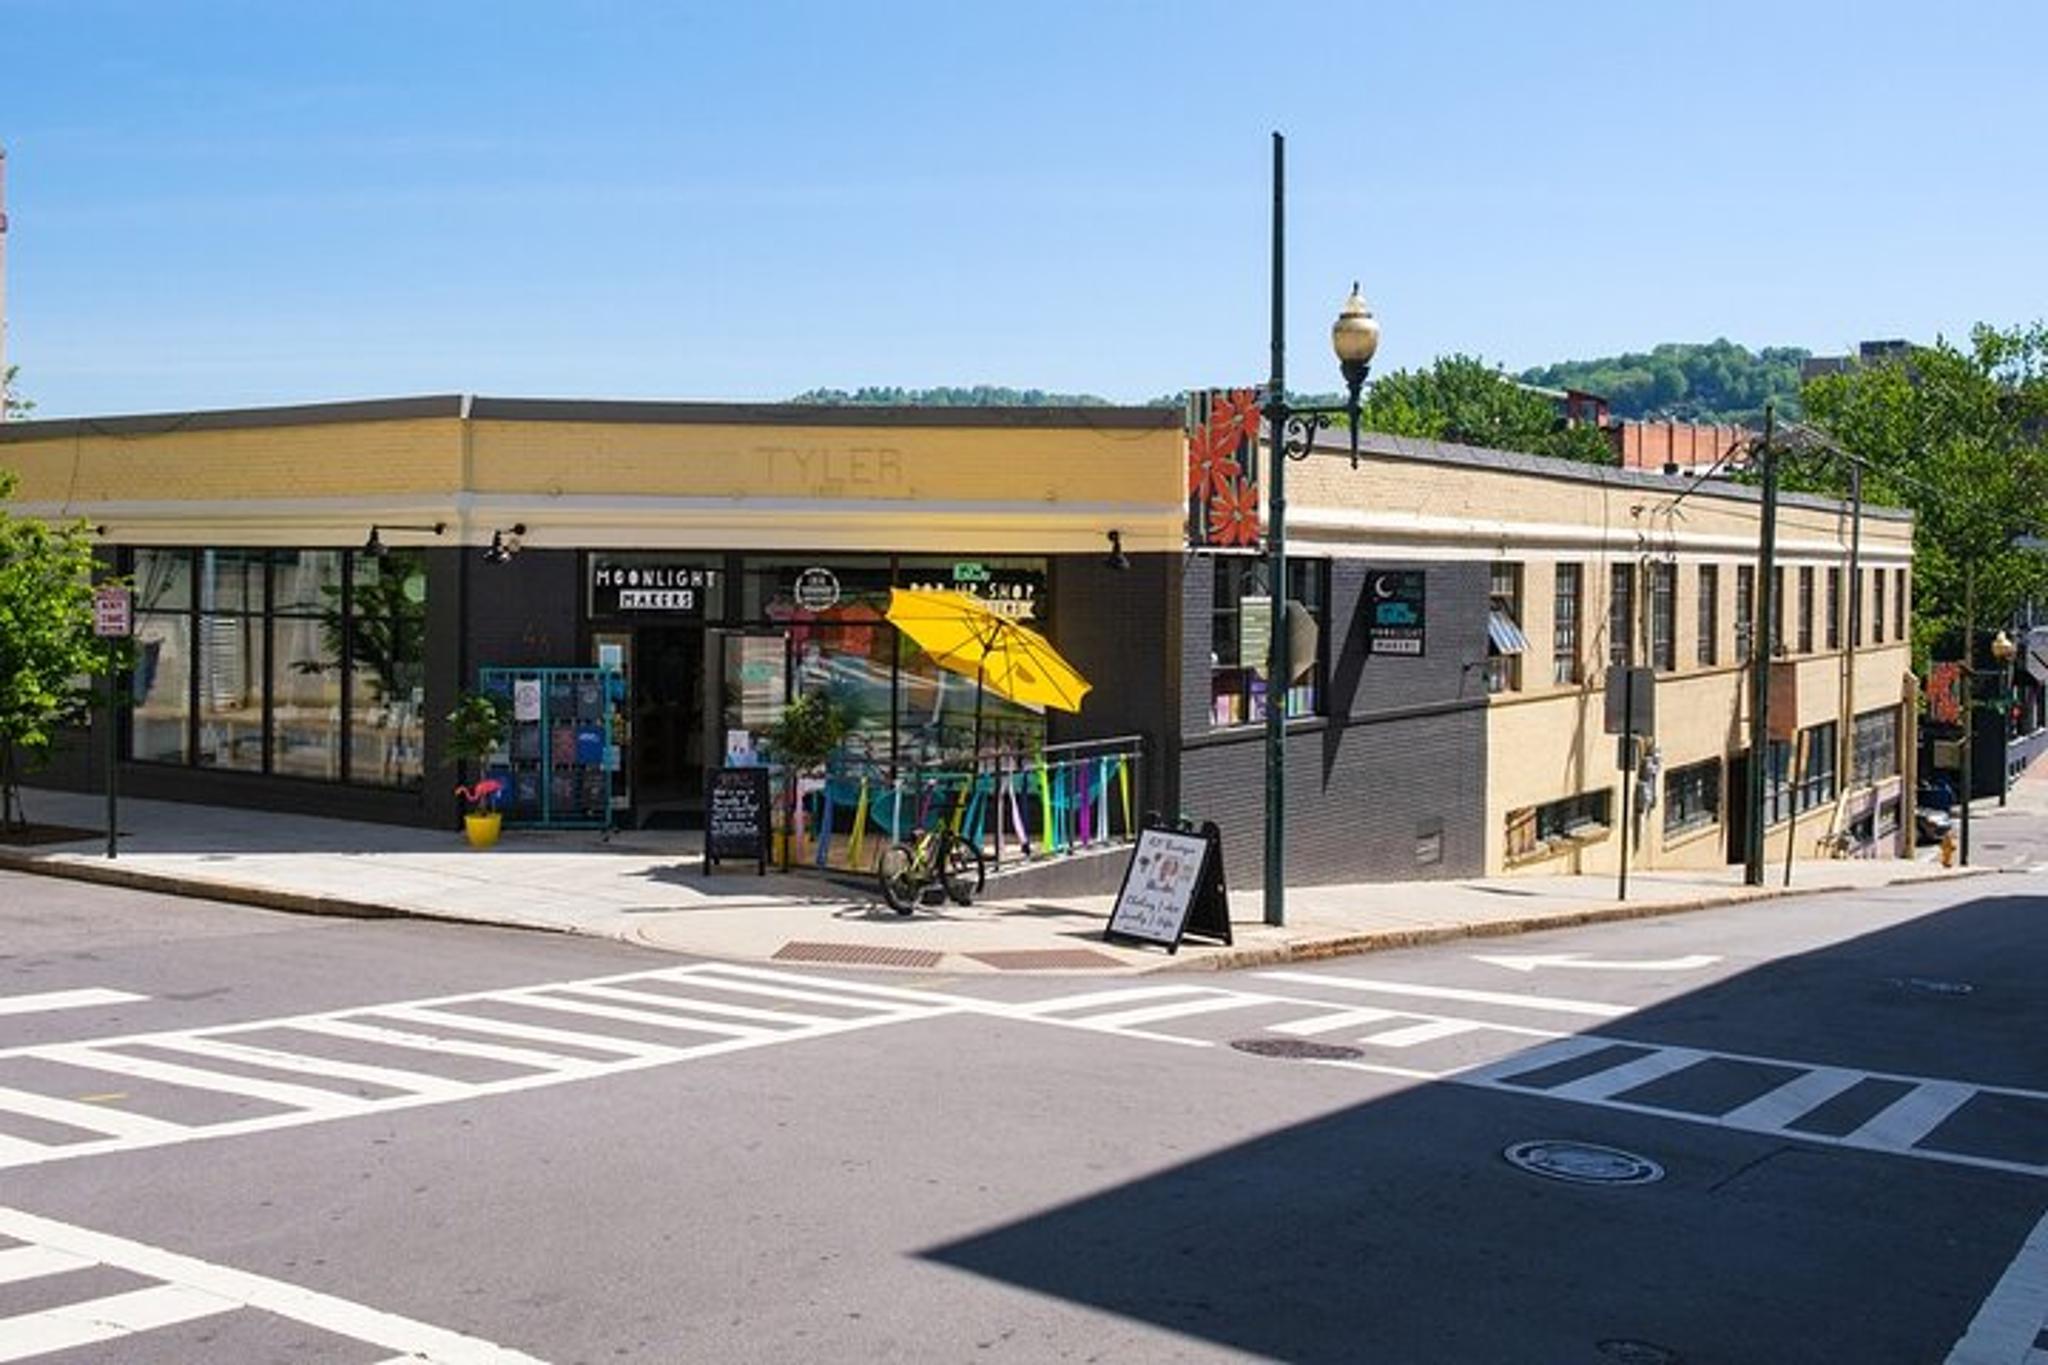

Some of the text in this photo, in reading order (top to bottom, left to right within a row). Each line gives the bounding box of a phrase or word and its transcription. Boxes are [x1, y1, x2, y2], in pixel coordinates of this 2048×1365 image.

[755, 447, 904, 484] TYLER
[596, 568, 717, 588] MOONLIGHT
[621, 591, 692, 609] MAKERS
[988, 583, 1034, 600] SHOP
